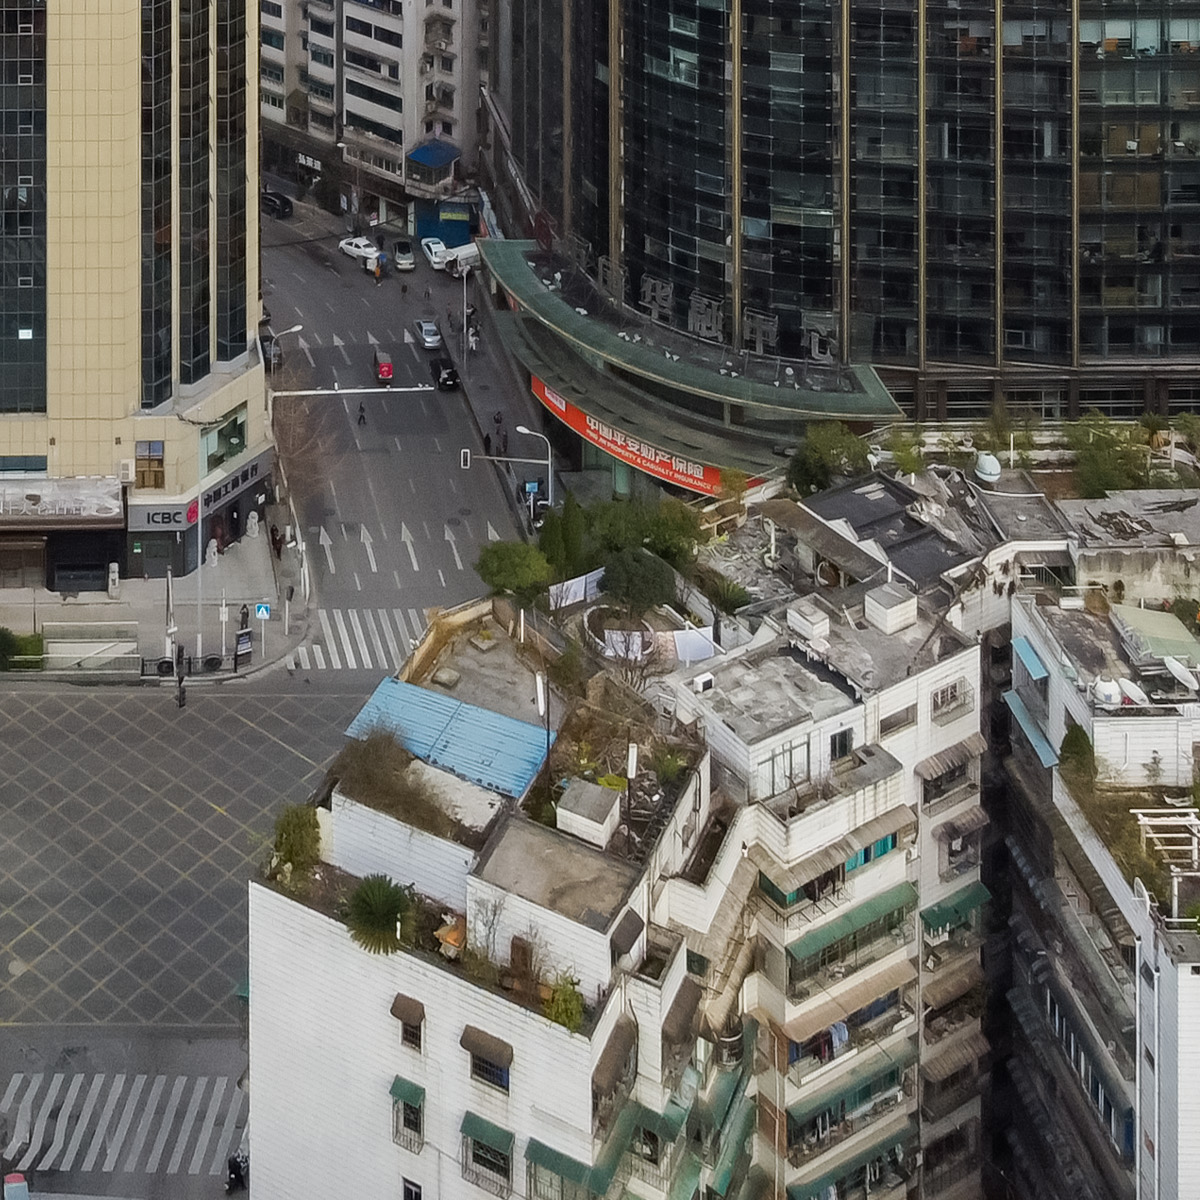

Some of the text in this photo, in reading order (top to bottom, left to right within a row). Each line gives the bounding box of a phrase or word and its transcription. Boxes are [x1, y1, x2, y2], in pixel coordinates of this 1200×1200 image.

[586, 415, 705, 479] 中国平安财产保险
[147, 511, 182, 524] ICBC
